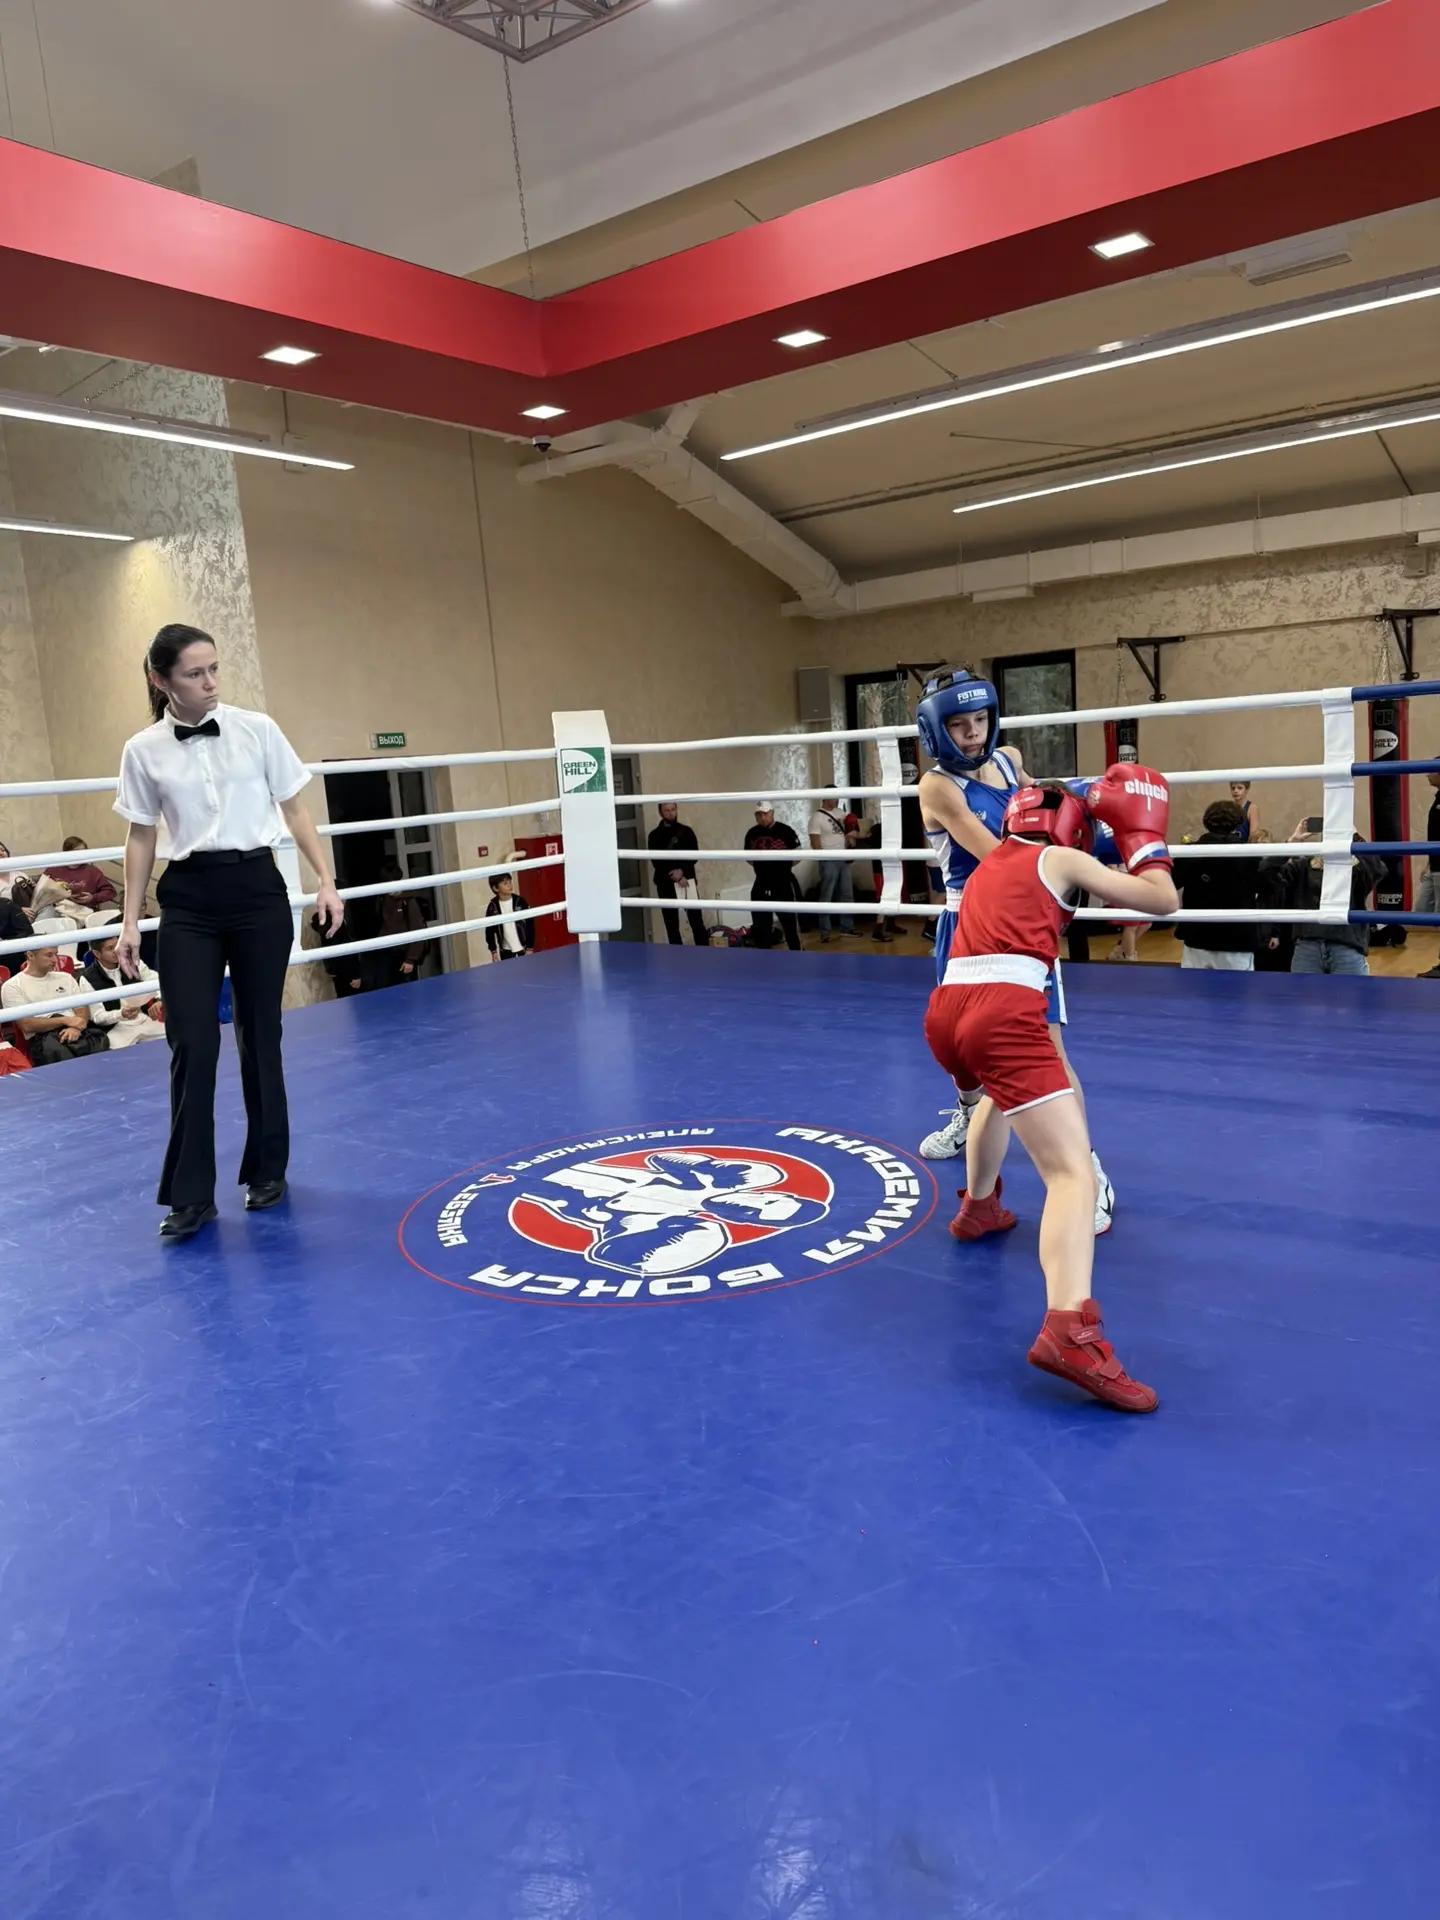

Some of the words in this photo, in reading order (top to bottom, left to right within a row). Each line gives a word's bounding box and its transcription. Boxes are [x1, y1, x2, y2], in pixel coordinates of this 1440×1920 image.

[378, 735, 404, 746] ВЫХОД
[563, 761, 597, 769] GREEN
[565, 767, 593, 776] HILL
[1124, 777, 1168, 804] clinch
[505, 1127, 715, 1171] АЛЕКСАНДРА
[775, 1127, 920, 1264] АКАДЕМИЯ
[467, 1262, 784, 1298] БОКСА
